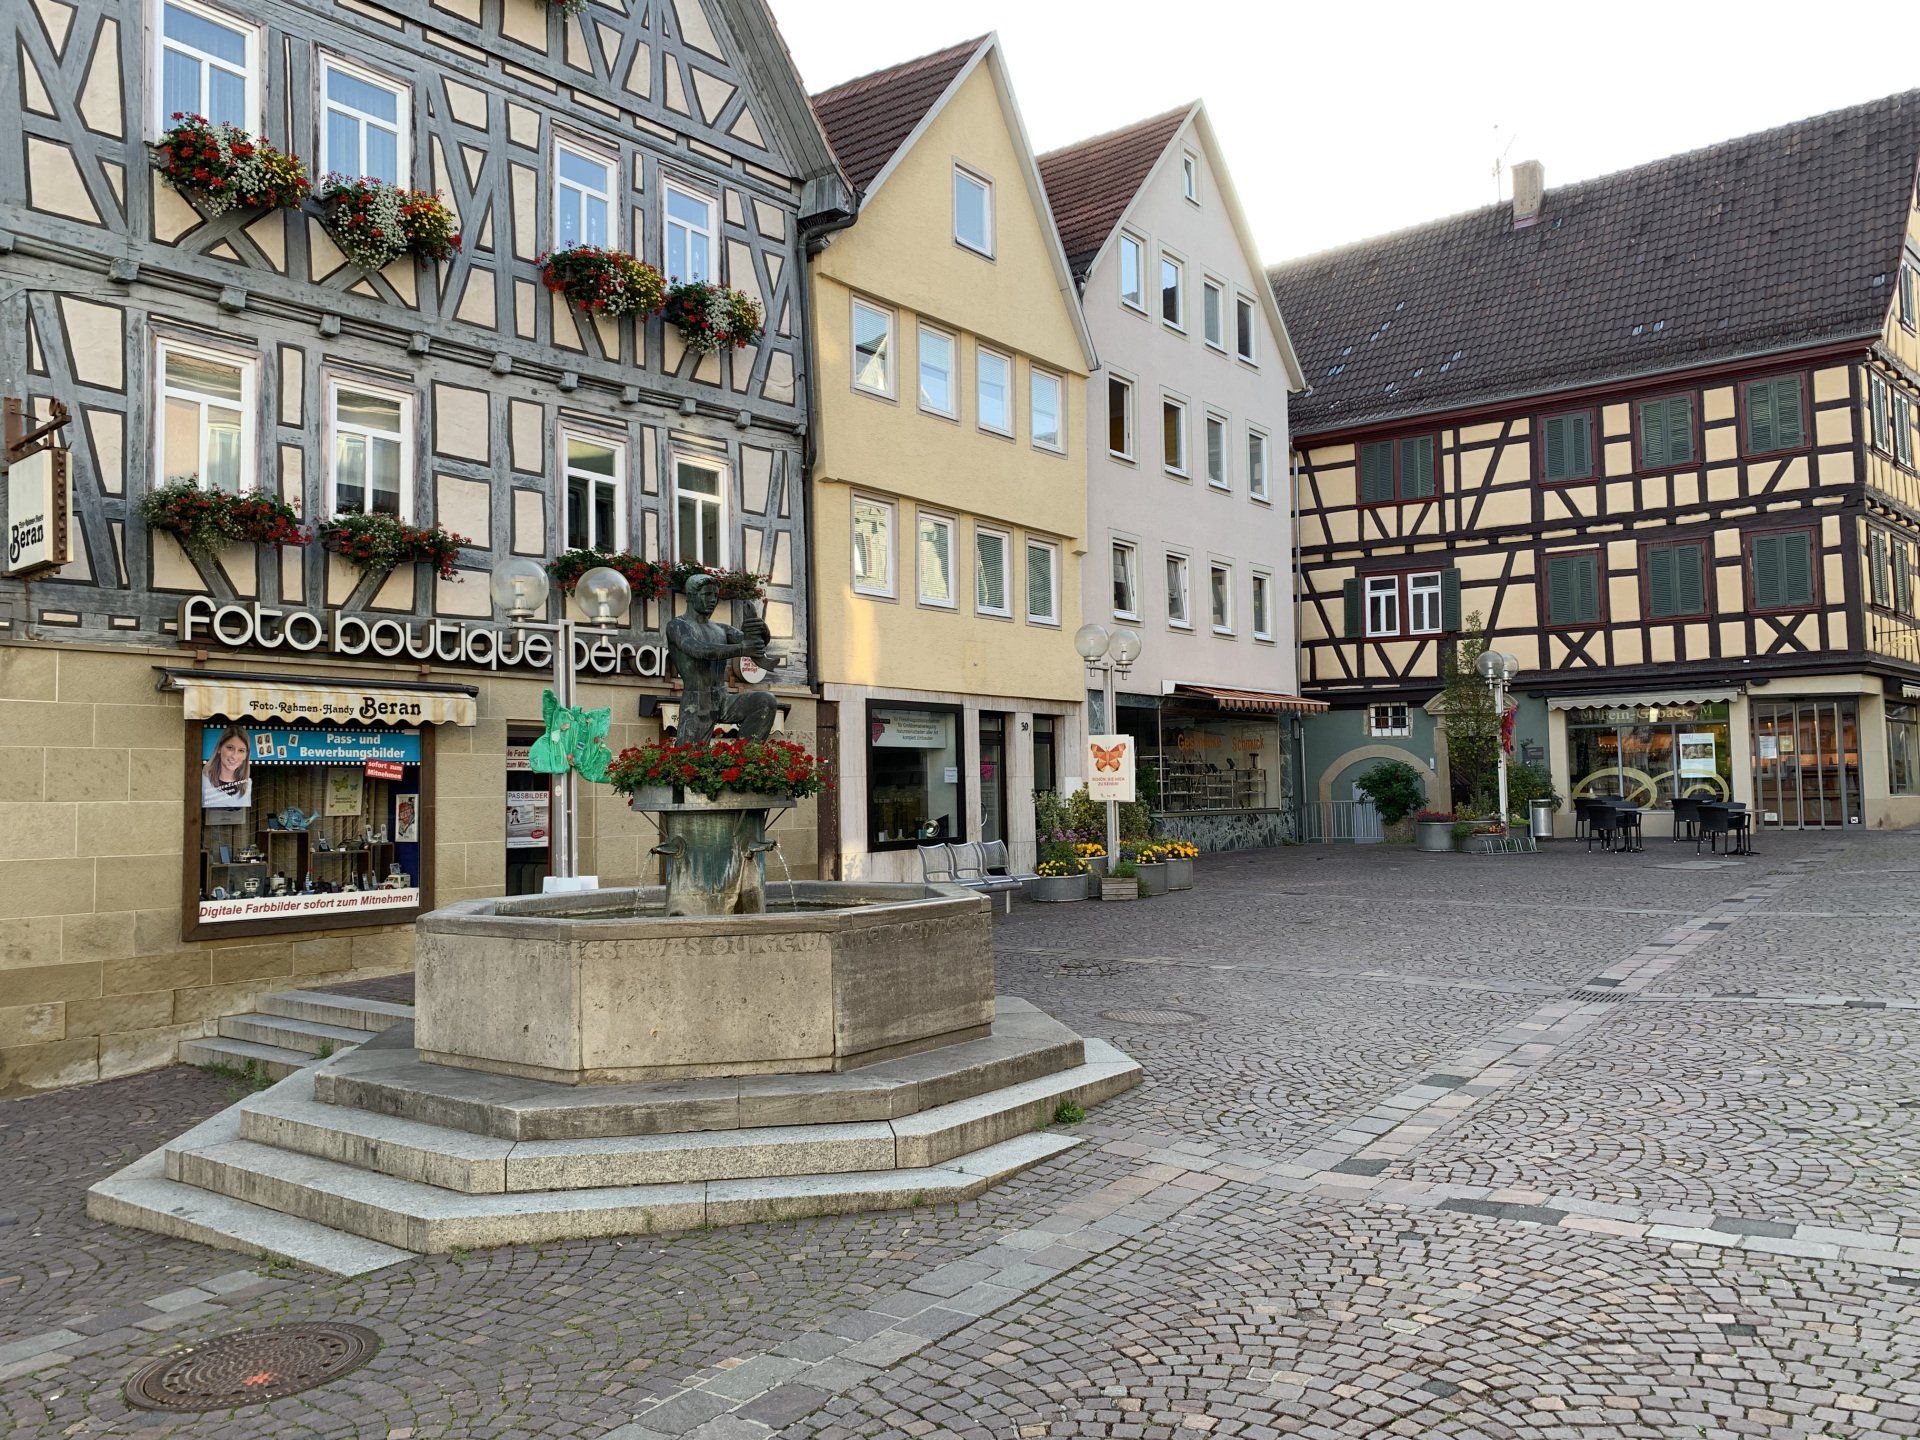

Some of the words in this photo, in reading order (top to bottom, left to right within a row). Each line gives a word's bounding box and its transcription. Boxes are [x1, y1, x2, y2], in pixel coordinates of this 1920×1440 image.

[10, 525, 44, 563] Beran
[184, 595, 322, 650] foto
[335, 610, 552, 670] boutique
[359, 697, 422, 719] Beran
[326, 734, 356, 744] Pass-
[359, 734, 381, 745] und
[300, 747, 405, 760] Bewerbungsbilder
[367, 761, 387, 770] sofort
[367, 769, 402, 780] Mitnehmen
[199, 905, 242, 919] Digitale
[246, 901, 301, 914] Farbbilder
[304, 898, 334, 910] sofort
[336, 897, 358, 907] zum
[360, 894, 413, 905] Mitnehmen
